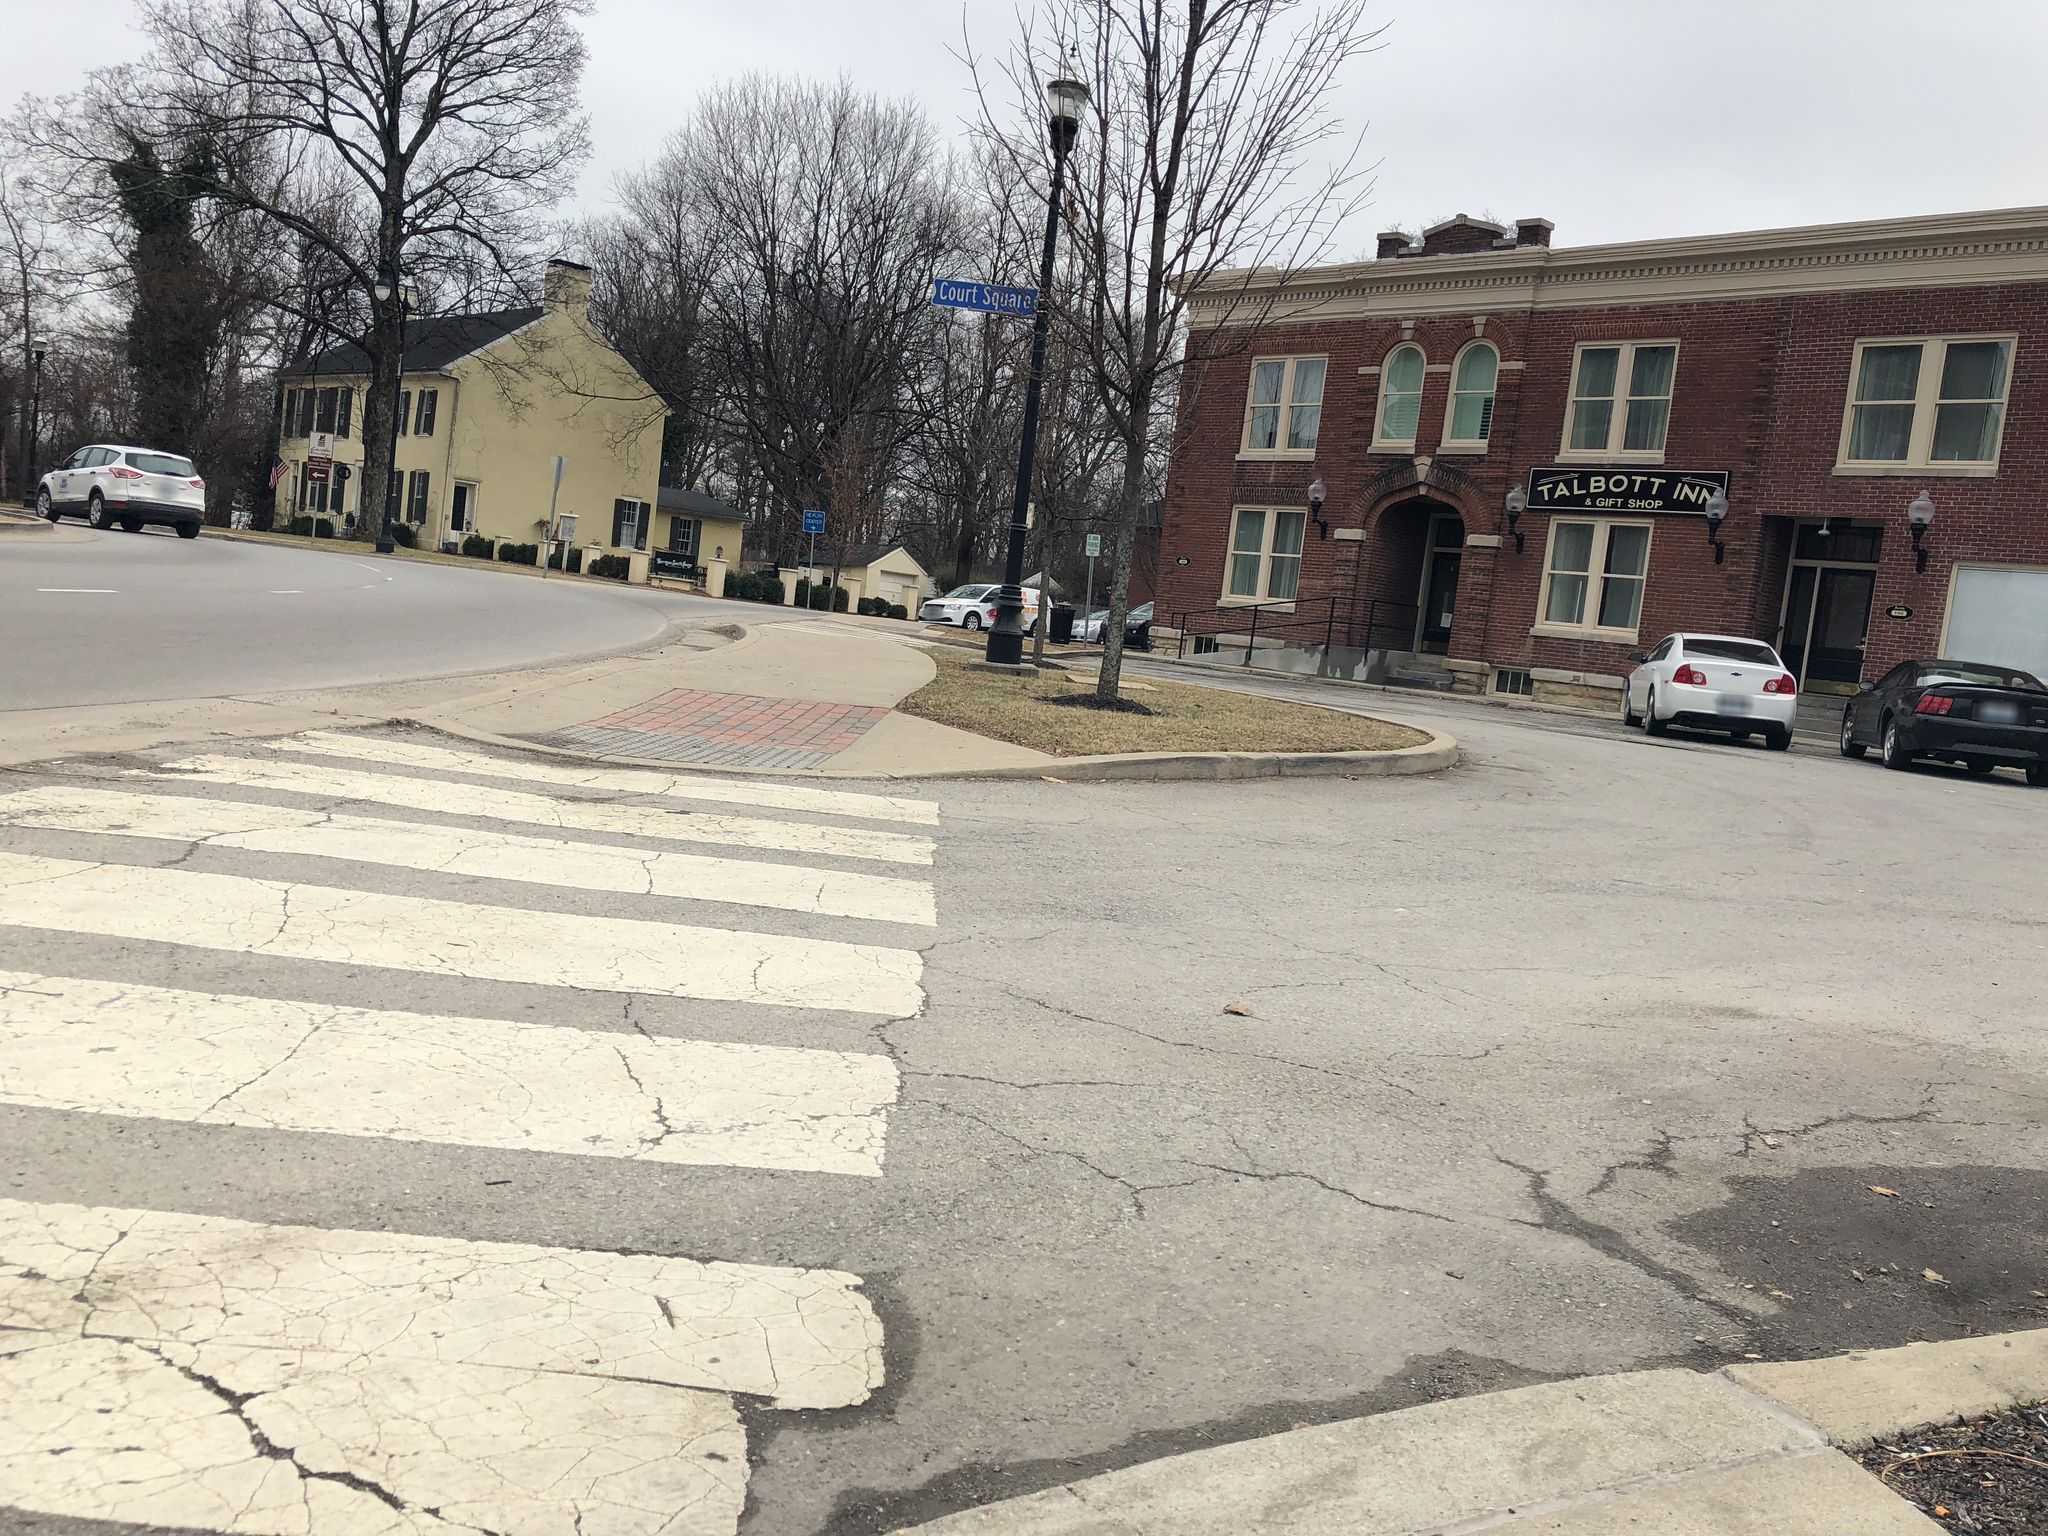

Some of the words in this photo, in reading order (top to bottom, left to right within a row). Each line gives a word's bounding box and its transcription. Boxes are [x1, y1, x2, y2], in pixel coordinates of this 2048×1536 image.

[940, 281, 977, 304] Court
[982, 286, 1031, 310] Square
[1537, 474, 1667, 501] TALBOTT
[1584, 498, 1592, 506] &
[1595, 497, 1624, 508] GIFT
[1627, 498, 1663, 509] SHOP
